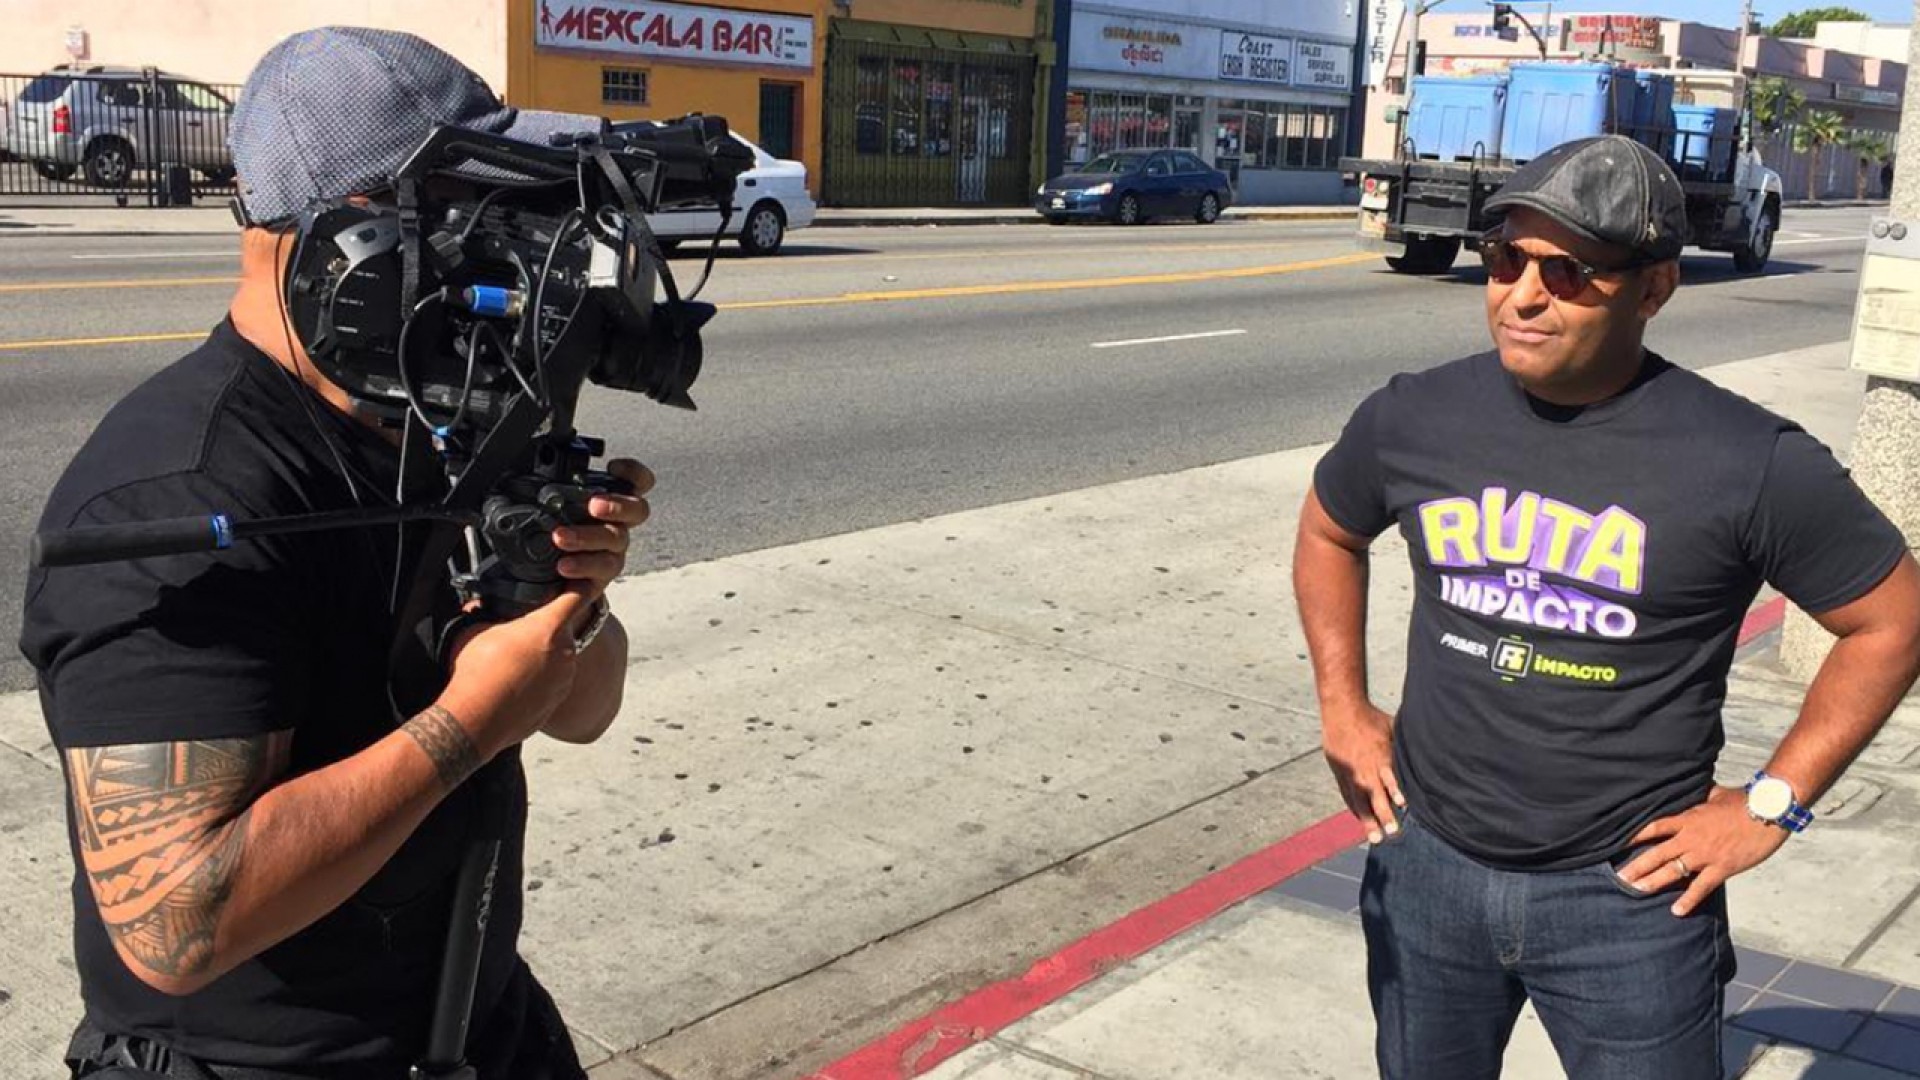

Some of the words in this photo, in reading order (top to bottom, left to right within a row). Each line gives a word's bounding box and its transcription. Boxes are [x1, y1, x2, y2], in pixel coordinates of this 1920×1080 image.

[554, 6, 703, 51] MEXCALA
[712, 20, 774, 55] BAR
[1238, 35, 1273, 56] COAST
[1250, 56, 1288, 81] REGISTER
[1419, 487, 1646, 594] RUTA
[1505, 569, 1541, 591] DE
[1440, 575, 1637, 638] IMPACTO
[1440, 633, 1489, 659] PRIMER
